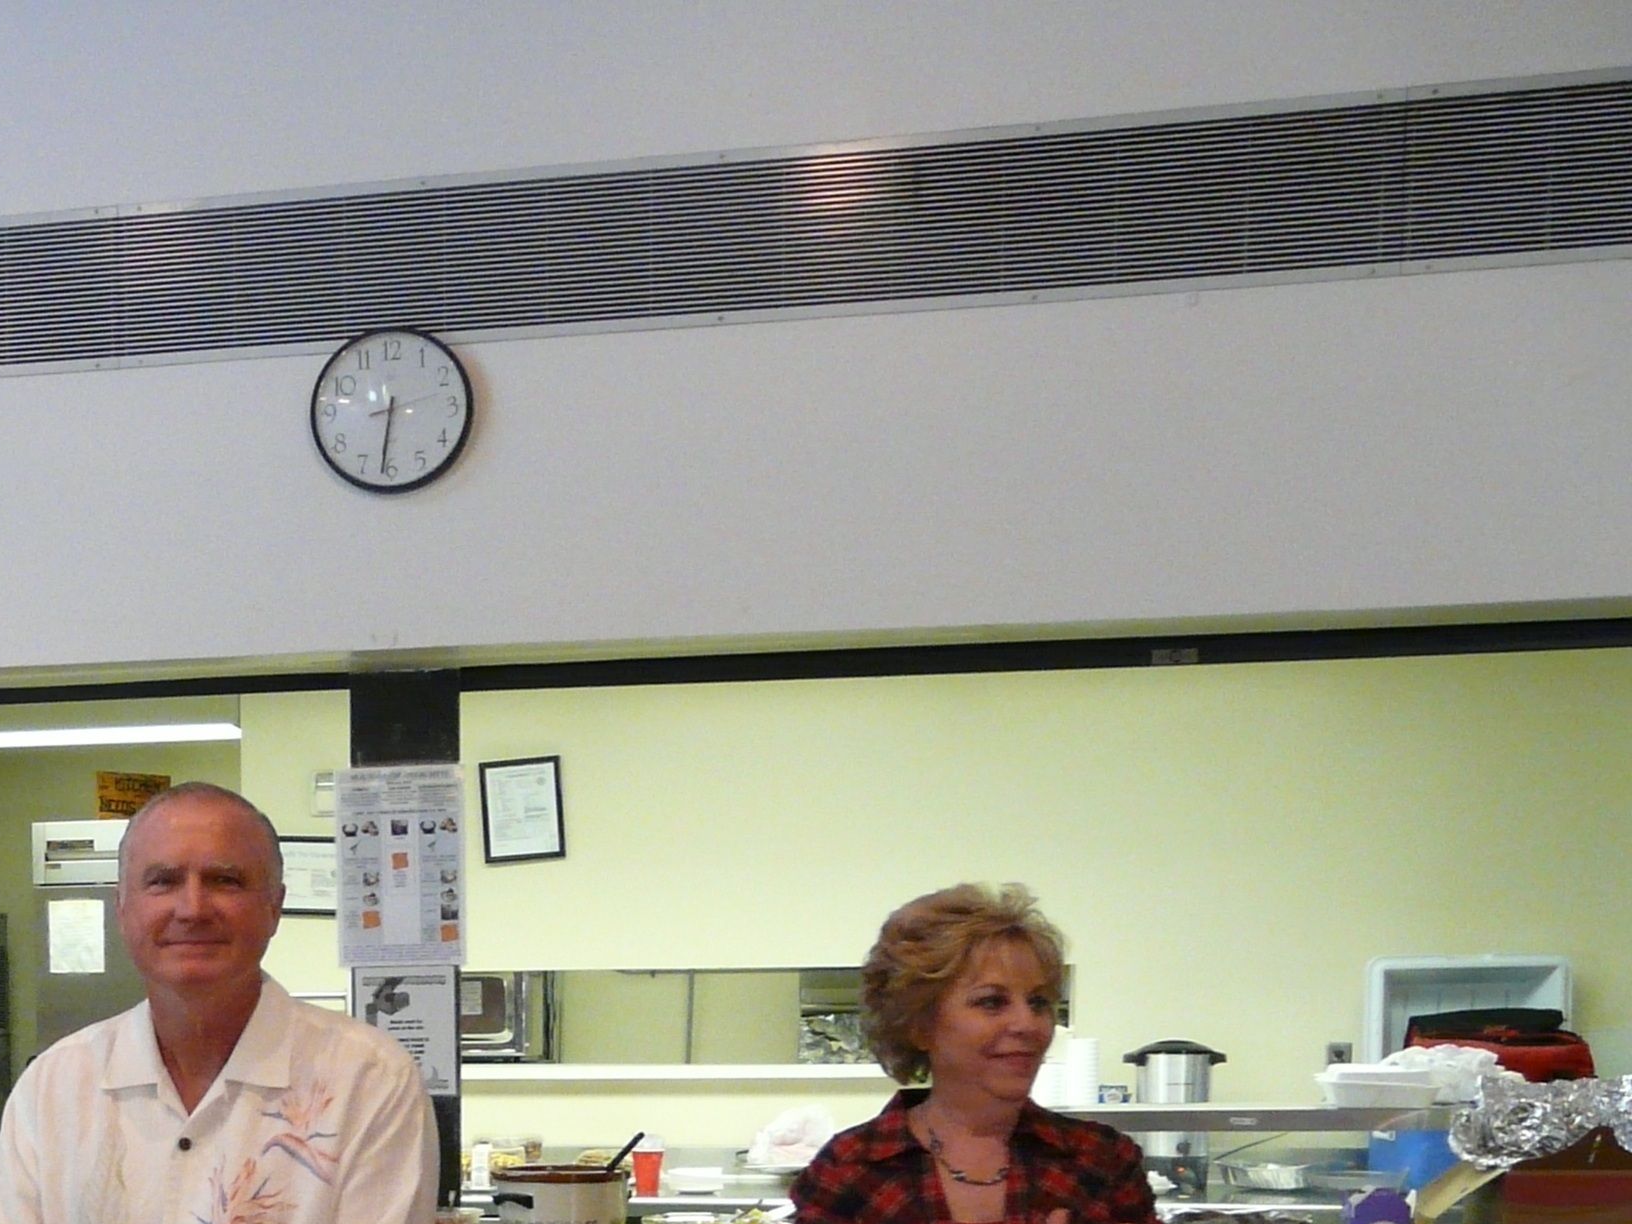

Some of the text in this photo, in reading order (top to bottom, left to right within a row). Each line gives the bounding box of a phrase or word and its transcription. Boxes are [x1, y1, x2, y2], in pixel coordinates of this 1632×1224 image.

[357, 351, 371, 370] 11
[382, 340, 402, 361] 12
[419, 347, 426, 368] 1
[334, 375, 356, 397] 10
[438, 366, 449, 387] 2
[323, 404, 337, 424] 9
[447, 396, 459, 418] 3
[333, 432, 347, 453] 8
[437, 427, 448, 447] 4
[356, 454, 369, 475] 7
[385, 458, 399, 480] 6
[414, 451, 427, 472] 5
